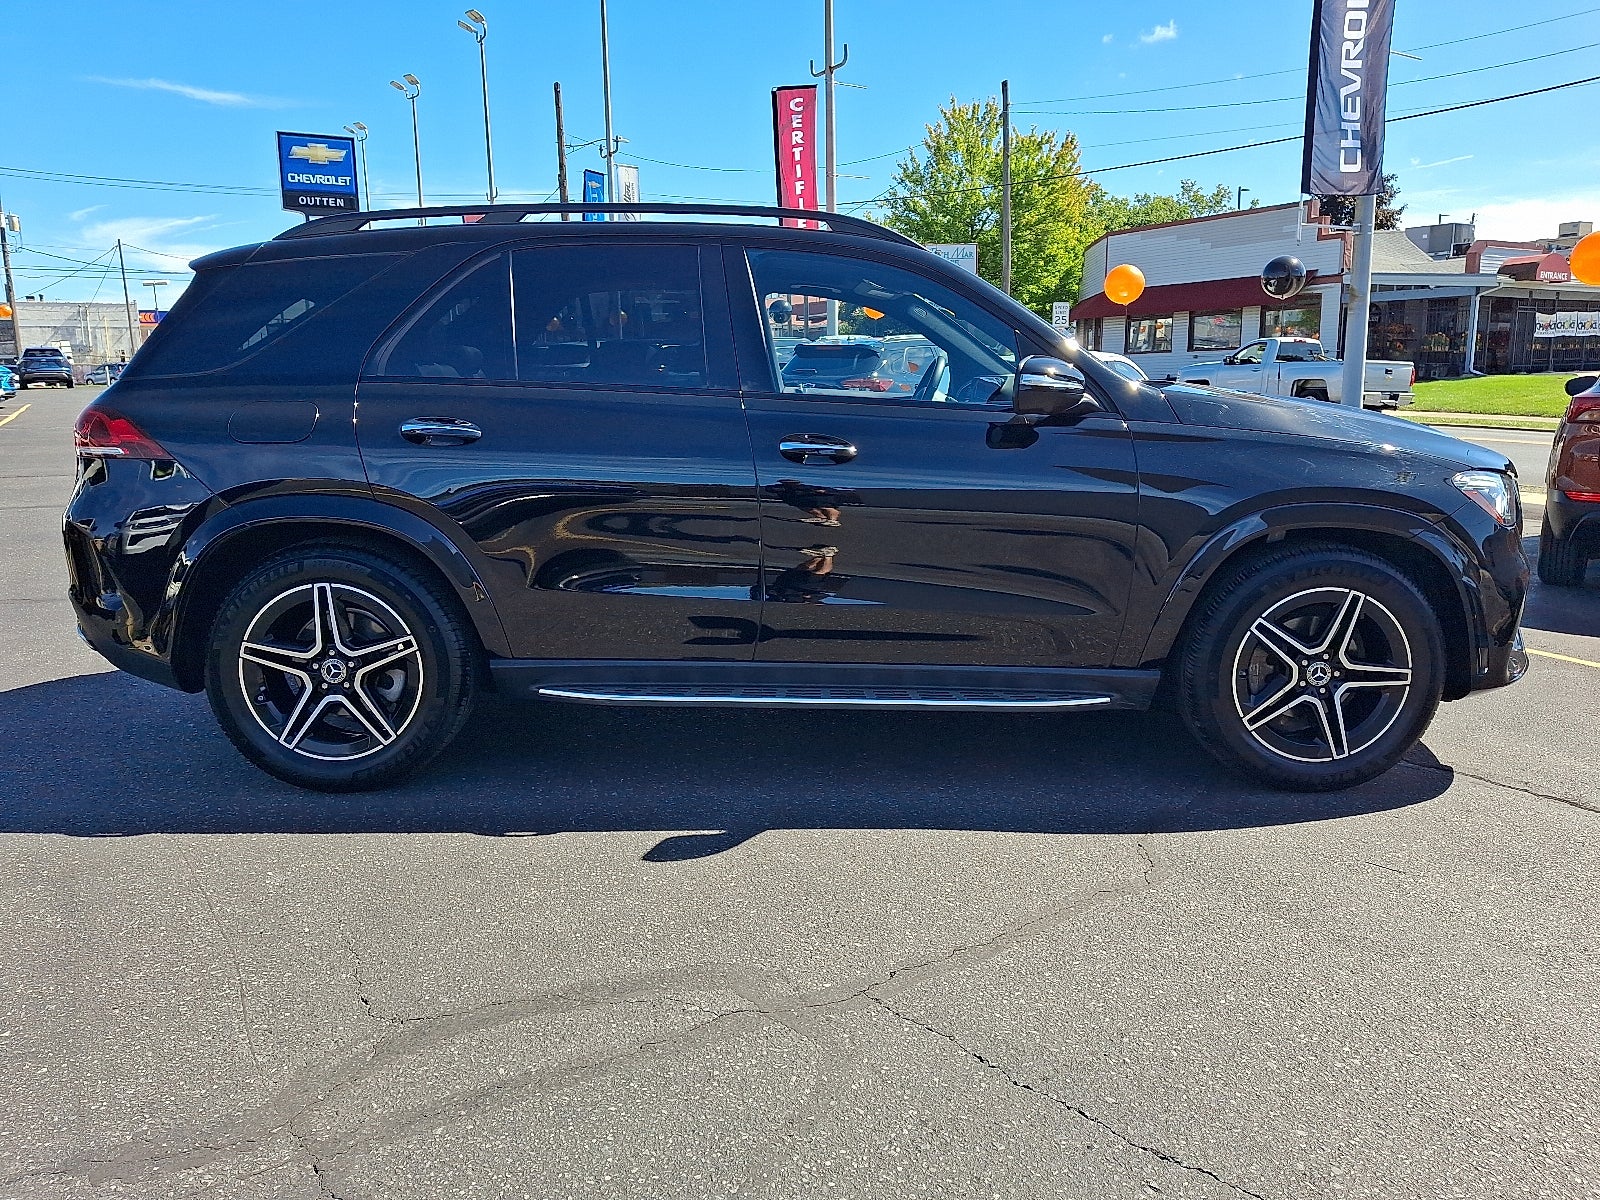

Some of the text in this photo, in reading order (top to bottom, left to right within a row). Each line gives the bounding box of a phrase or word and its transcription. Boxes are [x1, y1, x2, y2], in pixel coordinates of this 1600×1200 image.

[287, 172, 352, 186] CHEVROLET
[298, 196, 345, 207] OUTTEN
[1540, 271, 1568, 280] ENTRANCE
[1054, 315, 1068, 325] 25
